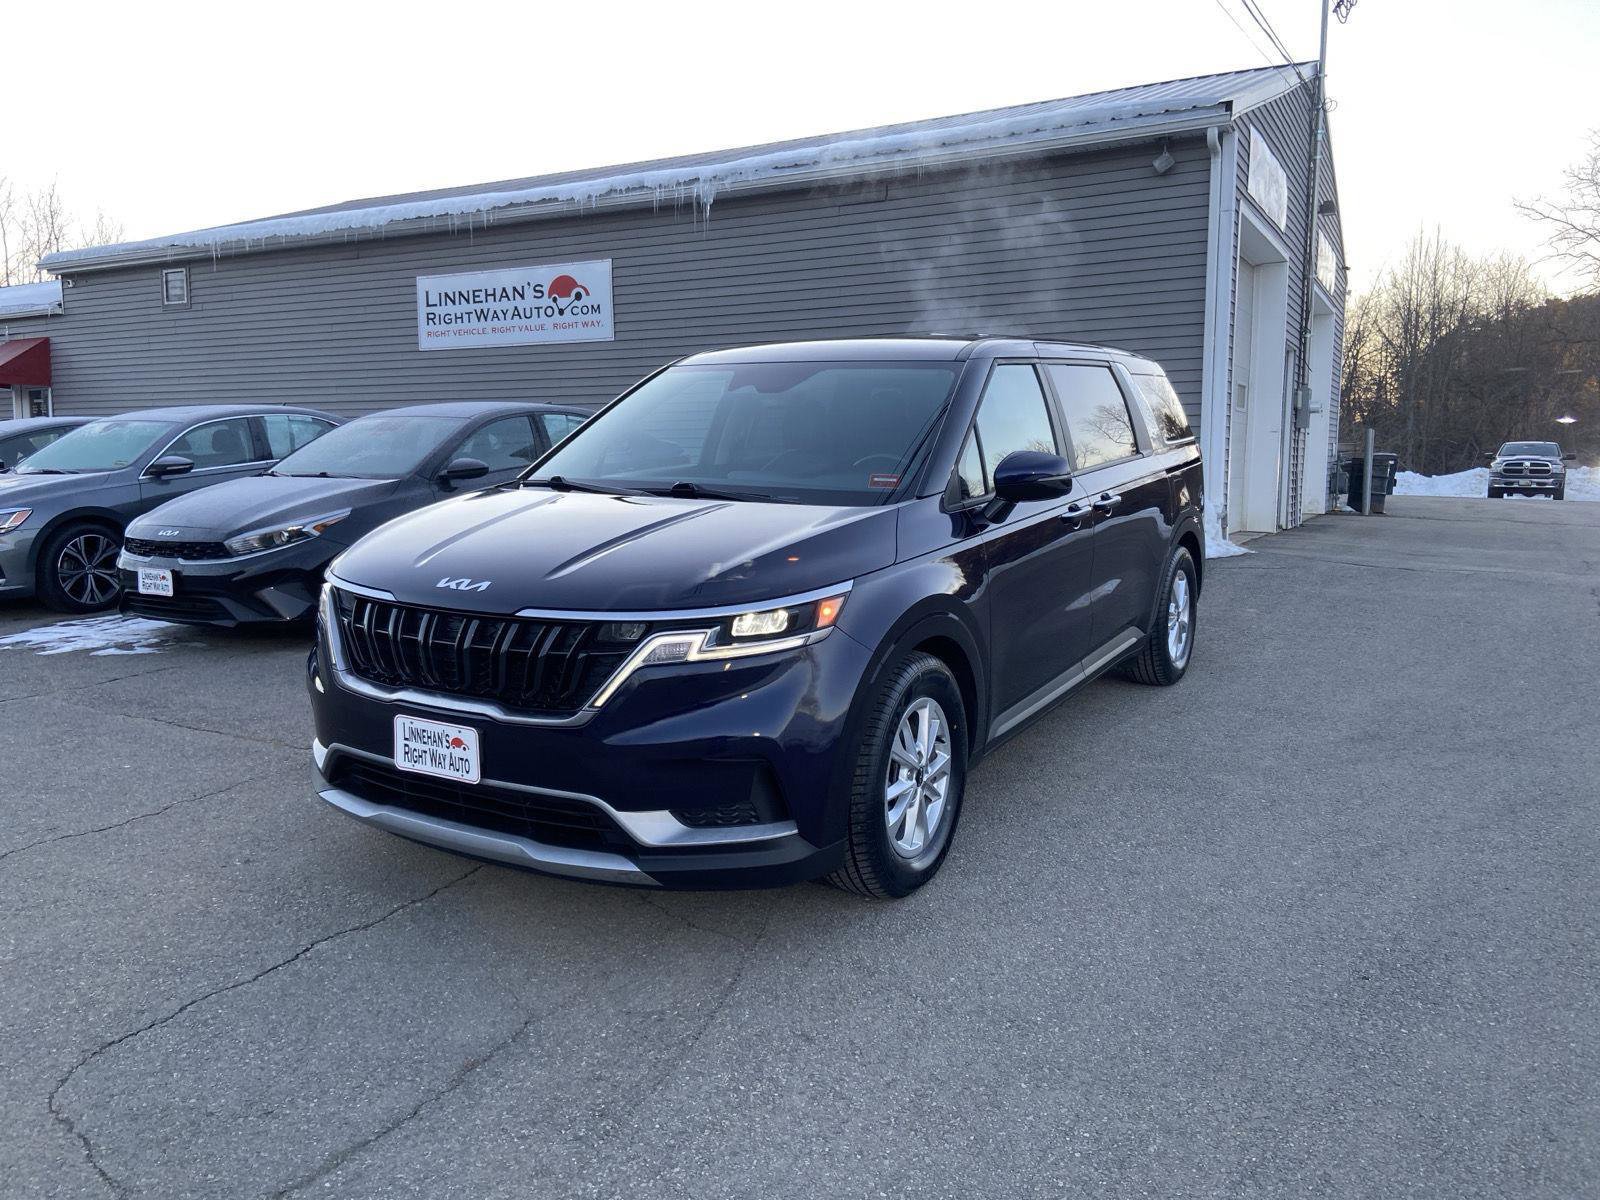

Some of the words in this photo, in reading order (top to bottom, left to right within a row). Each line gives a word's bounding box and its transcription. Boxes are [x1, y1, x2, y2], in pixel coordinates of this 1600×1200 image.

[425, 281, 545, 308] LINNEHAN'S
[427, 330, 451, 338] RIGHT
[491, 325, 517, 334] RIGHT
[553, 321, 580, 330] RIGHT
[403, 722, 451, 749] LINNEHAN'S
[404, 744, 427, 766] RIGHT
[429, 748, 447, 770] WAY
[449, 752, 470, 774] AUTO
